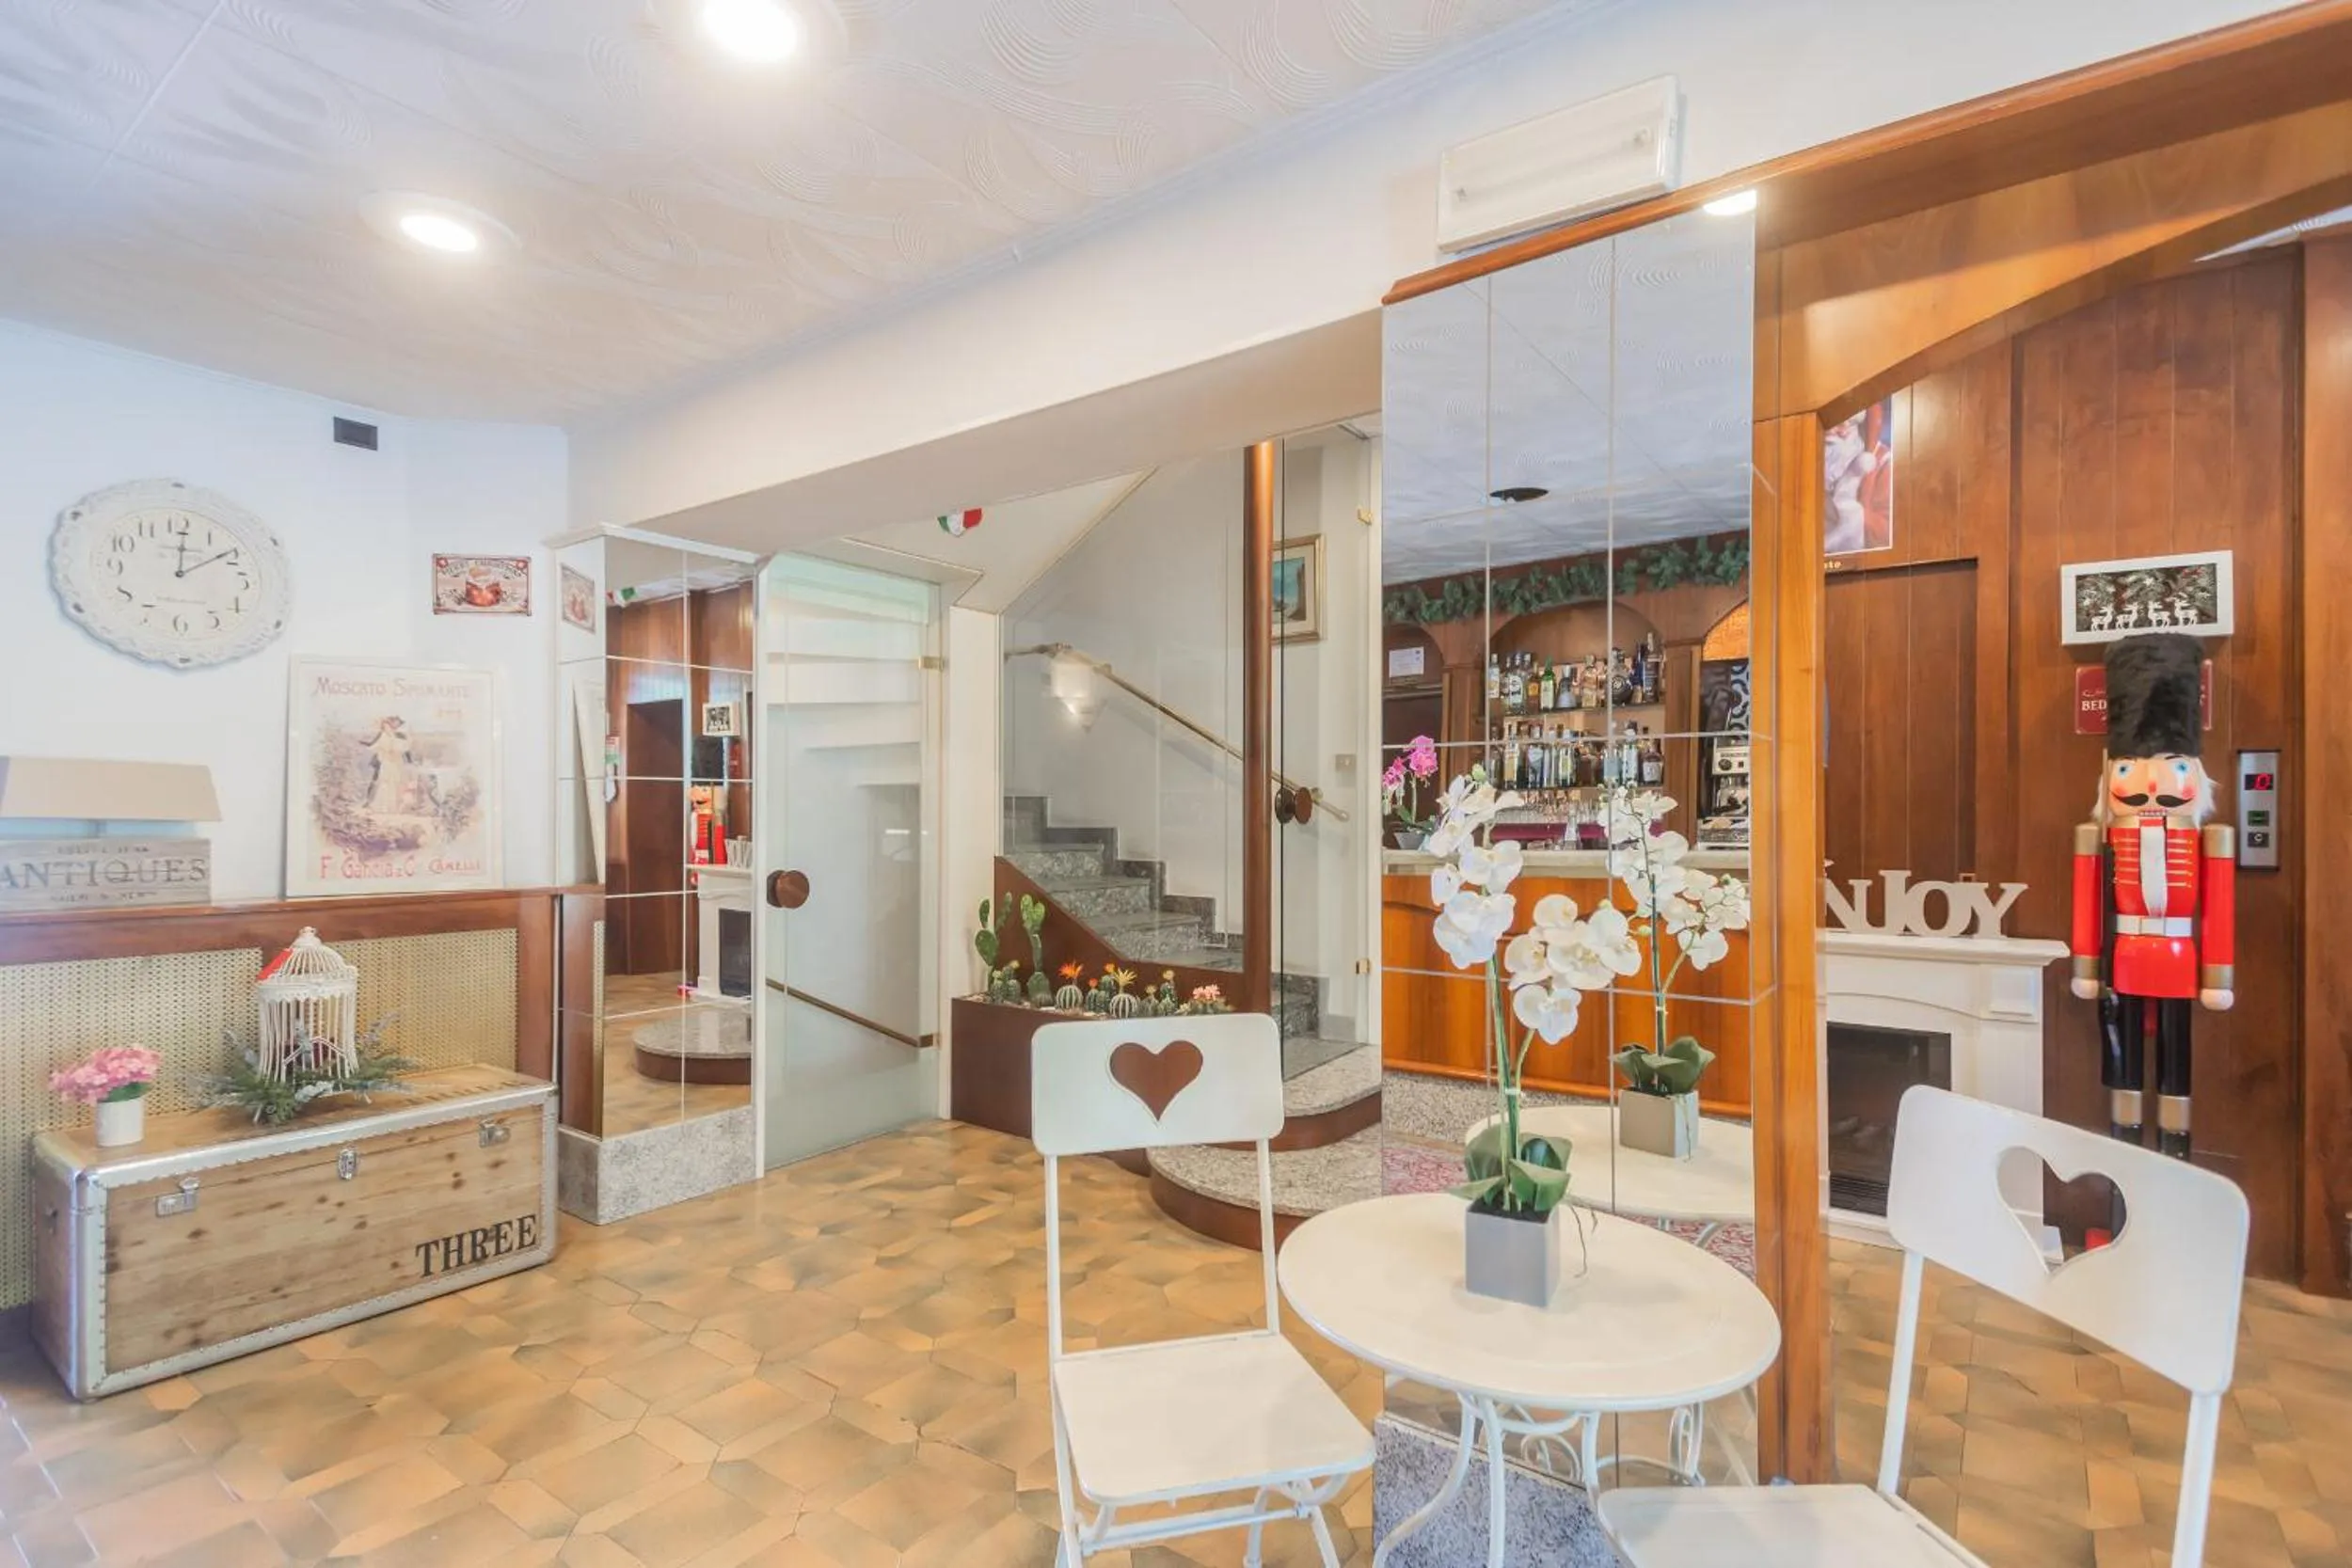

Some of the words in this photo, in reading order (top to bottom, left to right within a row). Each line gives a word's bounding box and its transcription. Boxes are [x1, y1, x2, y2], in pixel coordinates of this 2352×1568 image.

[167, 516, 189, 535] 12
[112, 533, 135, 553] 10
[107, 557, 124, 577] 9
[172, 613, 188, 633] 6
[0, 859, 206, 889] ANTIQUES
[416, 1214, 537, 1278] THREE
